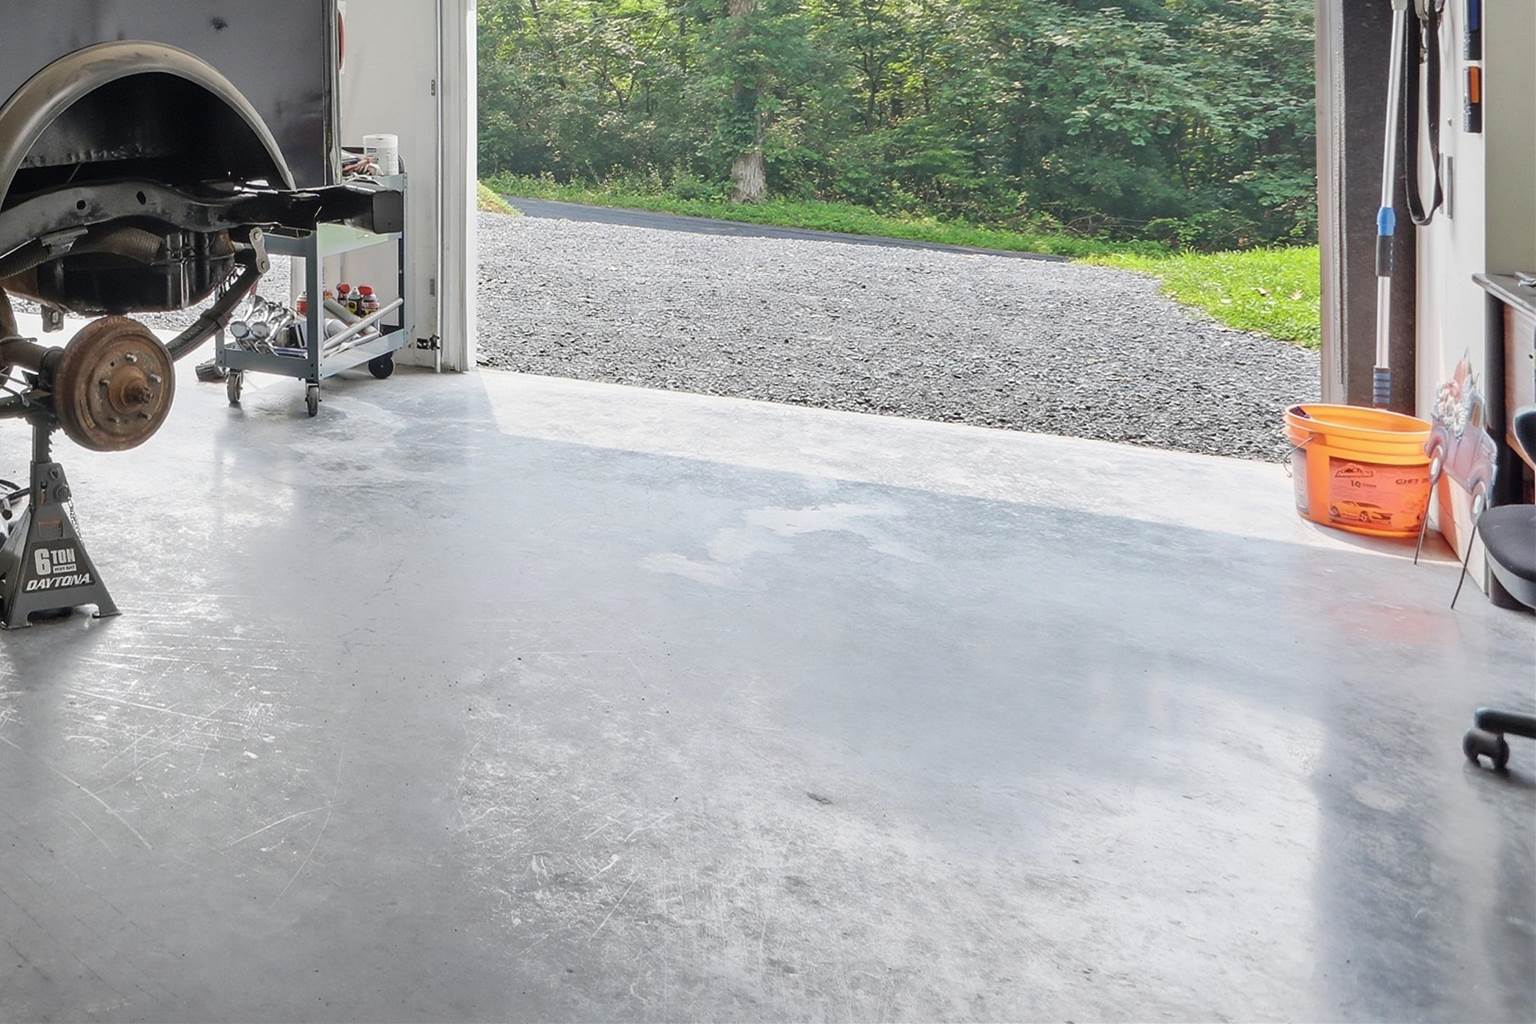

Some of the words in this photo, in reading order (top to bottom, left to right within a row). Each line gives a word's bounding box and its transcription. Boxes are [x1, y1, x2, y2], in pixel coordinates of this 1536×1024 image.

[34, 548, 52, 576] 6
[50, 548, 76, 565] TON
[26, 573, 91, 591] DAYTONA
